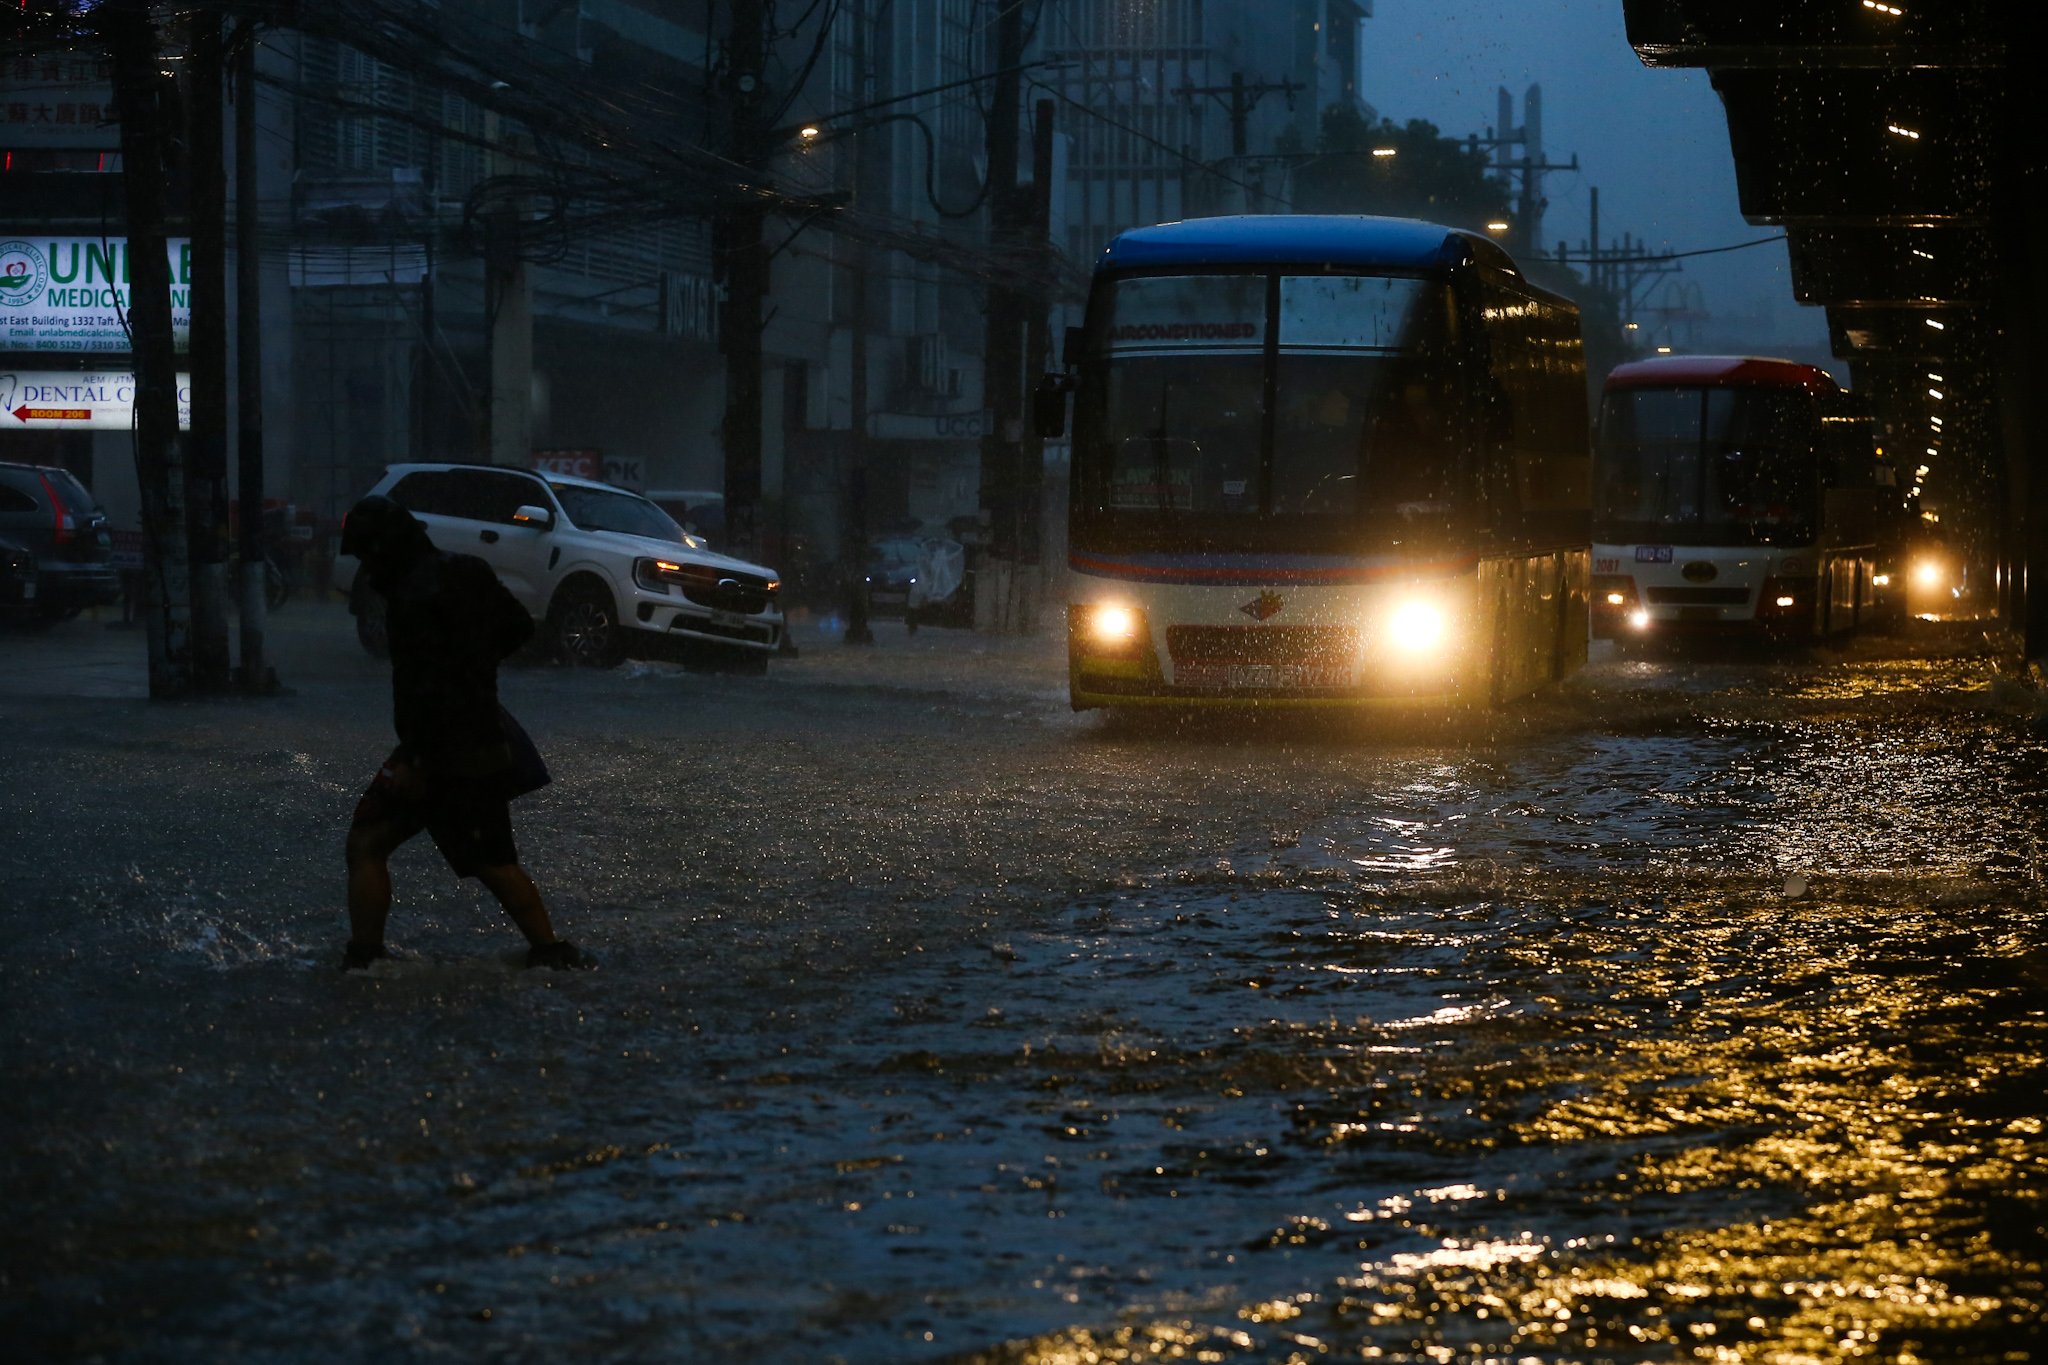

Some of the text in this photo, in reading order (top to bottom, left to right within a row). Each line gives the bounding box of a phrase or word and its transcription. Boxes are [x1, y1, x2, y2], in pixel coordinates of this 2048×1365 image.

[48, 288, 132, 308] MEDICA
[10, 316, 29, 326] East
[32, 316, 69, 328] Building
[72, 316, 94, 326] 1332
[97, 316, 114, 326] Taft
[9, 328, 132, 338] Email: unlabmedicalclinic@
[36, 341, 57, 350] 8400
[60, 341, 82, 350] 5129
[92, 341, 113, 350] 5310
[24, 386, 111, 402] DENTAL
[31, 410, 63, 418] ROOM
[536, 457, 592, 477] KFC
